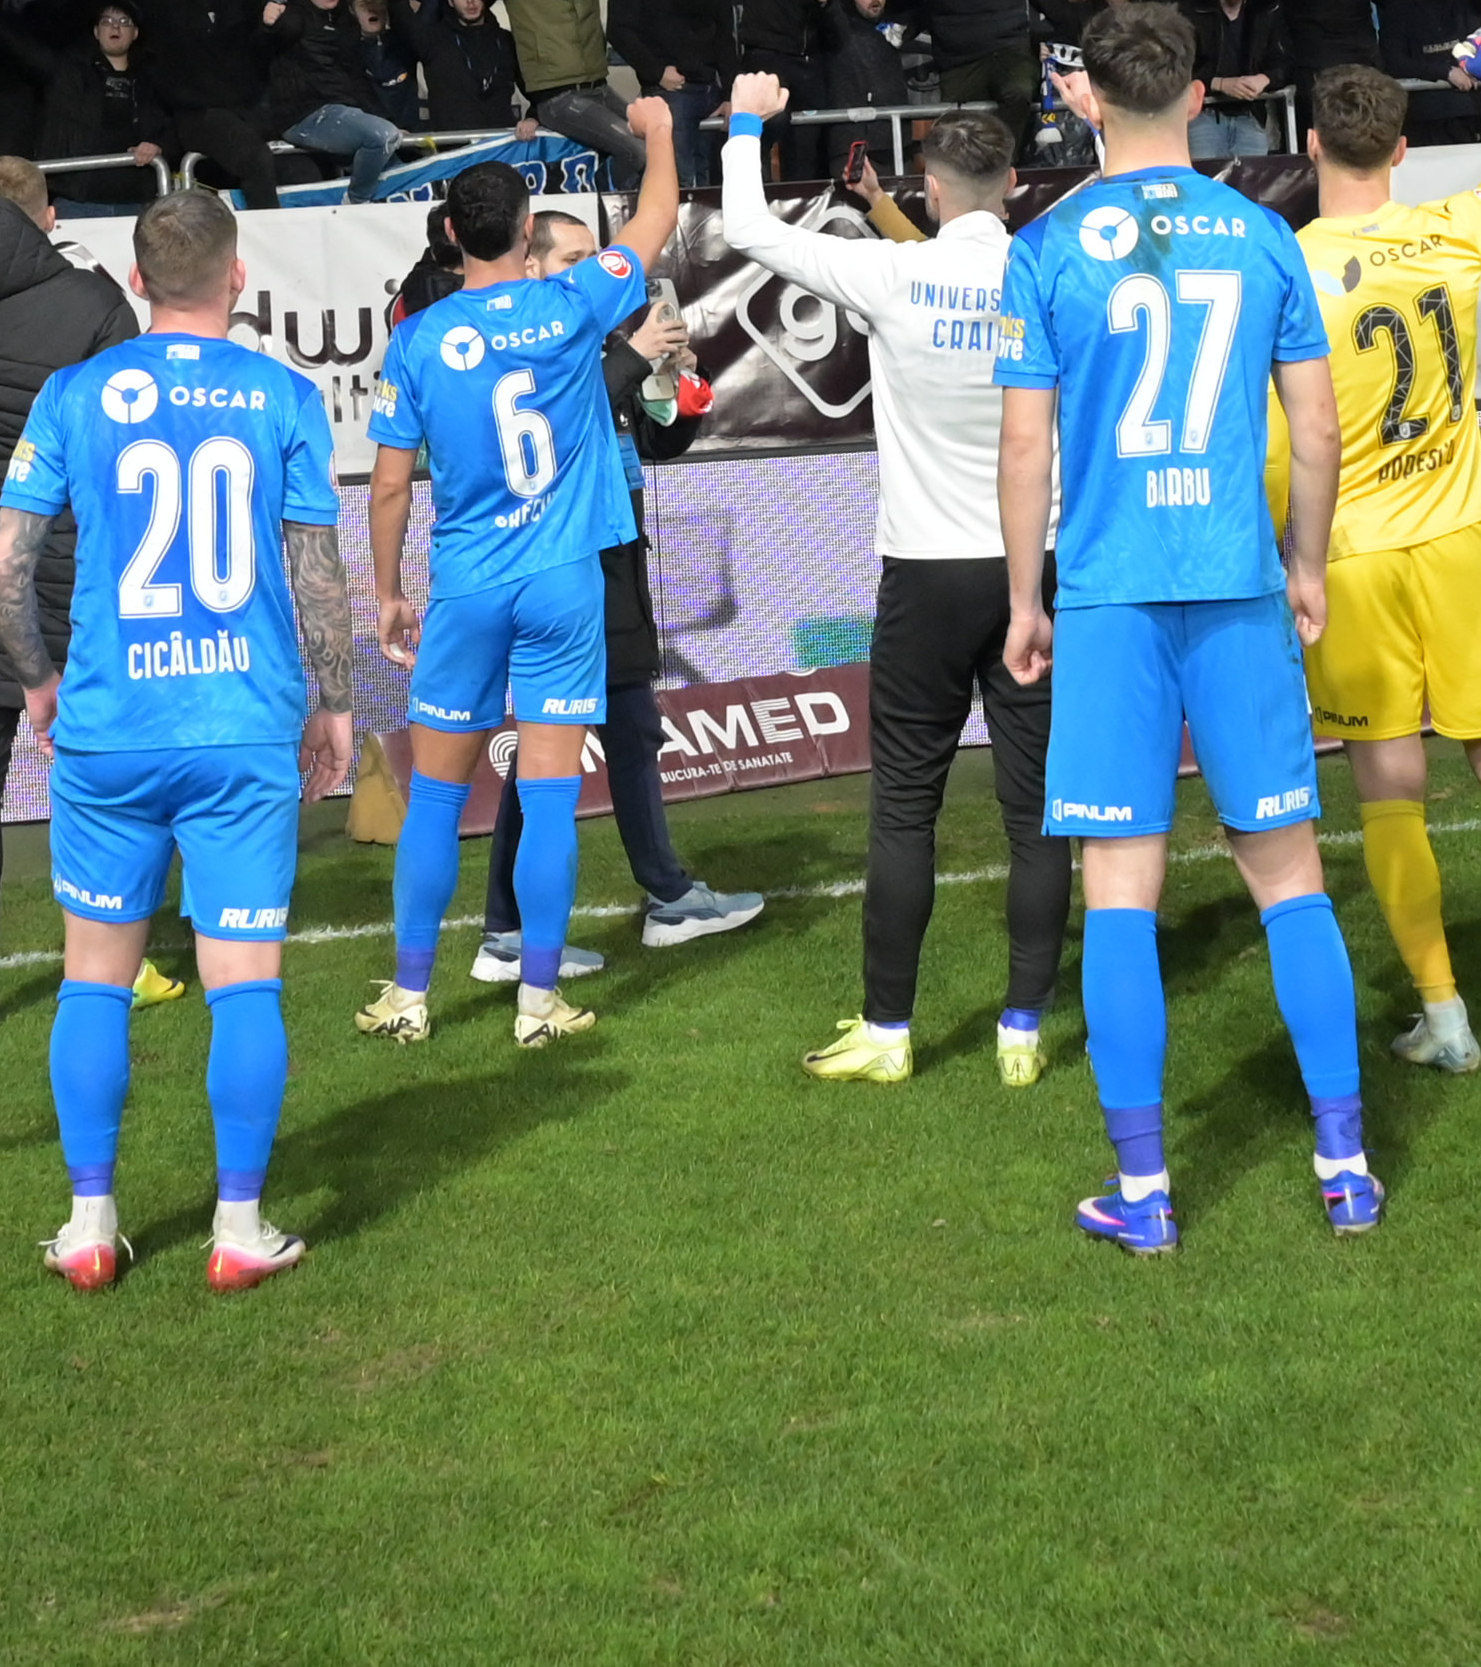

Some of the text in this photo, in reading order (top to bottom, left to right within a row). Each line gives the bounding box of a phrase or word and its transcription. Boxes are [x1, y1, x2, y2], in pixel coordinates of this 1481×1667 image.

[1150, 213, 1247, 239] OSCAR
[1369, 234, 1444, 268] OSCAR
[910, 281, 1001, 314] UNIVERS
[491, 320, 565, 352] OSCAR
[1107, 270, 1242, 459] 27
[1352, 283, 1465, 449] 21
[169, 385, 266, 412] OSCAR
[491, 368, 558, 498] 6
[1146, 467, 1211, 509] BARBU
[116, 435, 256, 619] 20
[127, 630, 251, 681] CICÂLDĂU
[419, 701, 472, 722] PINUM
[541, 698, 599, 715] RURIS
[1322, 713, 1370, 728] PINUM
[660, 751, 794, 785] BUCURA-TE DE SANATATE
[1062, 804, 1133, 821] PINUM
[1255, 786, 1312, 820] RURIS
[61, 884, 123, 910] PINUM
[218, 907, 288, 930] RURIS
